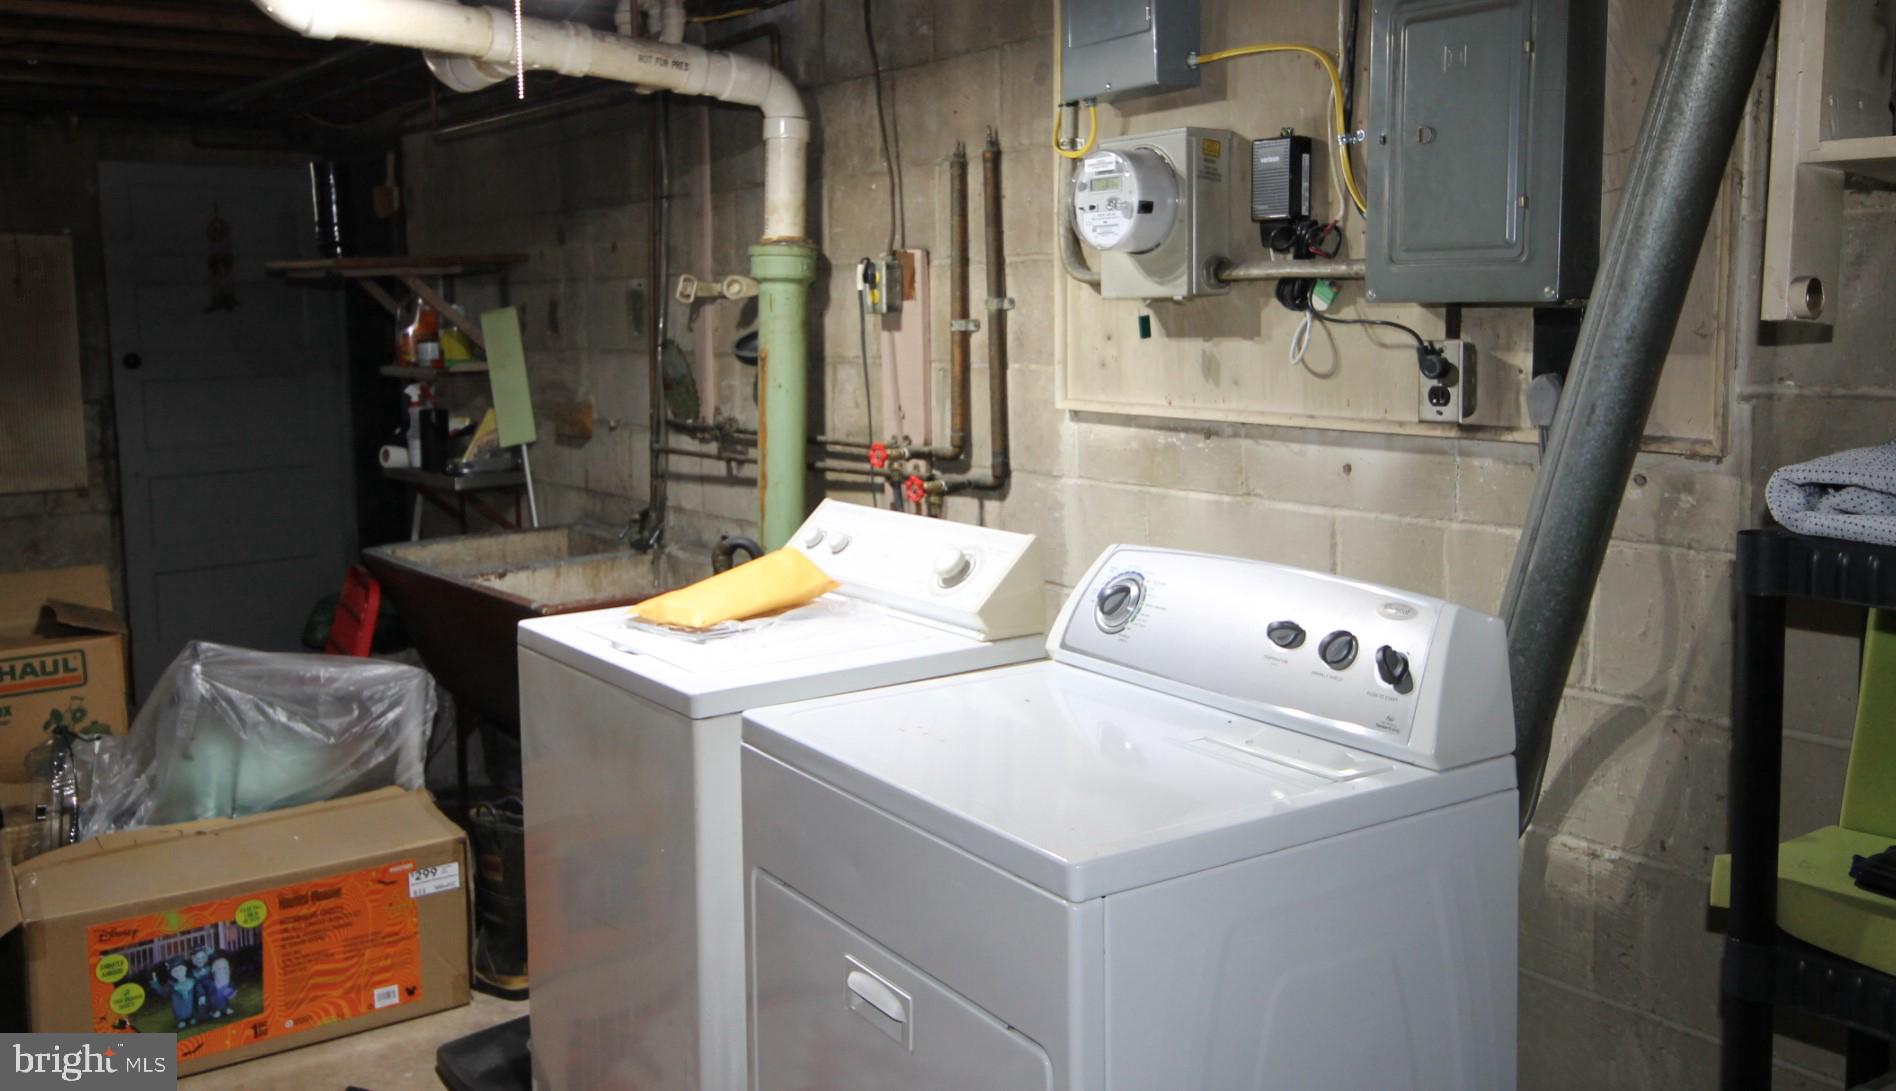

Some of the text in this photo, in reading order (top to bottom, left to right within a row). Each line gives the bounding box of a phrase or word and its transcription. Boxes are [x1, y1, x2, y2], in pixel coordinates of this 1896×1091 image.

[638, 54, 653, 64] NOT
[655, 57, 669, 67] FOR
[0, 657, 78, 681] HAUL
[97, 928, 139, 944] Disney
